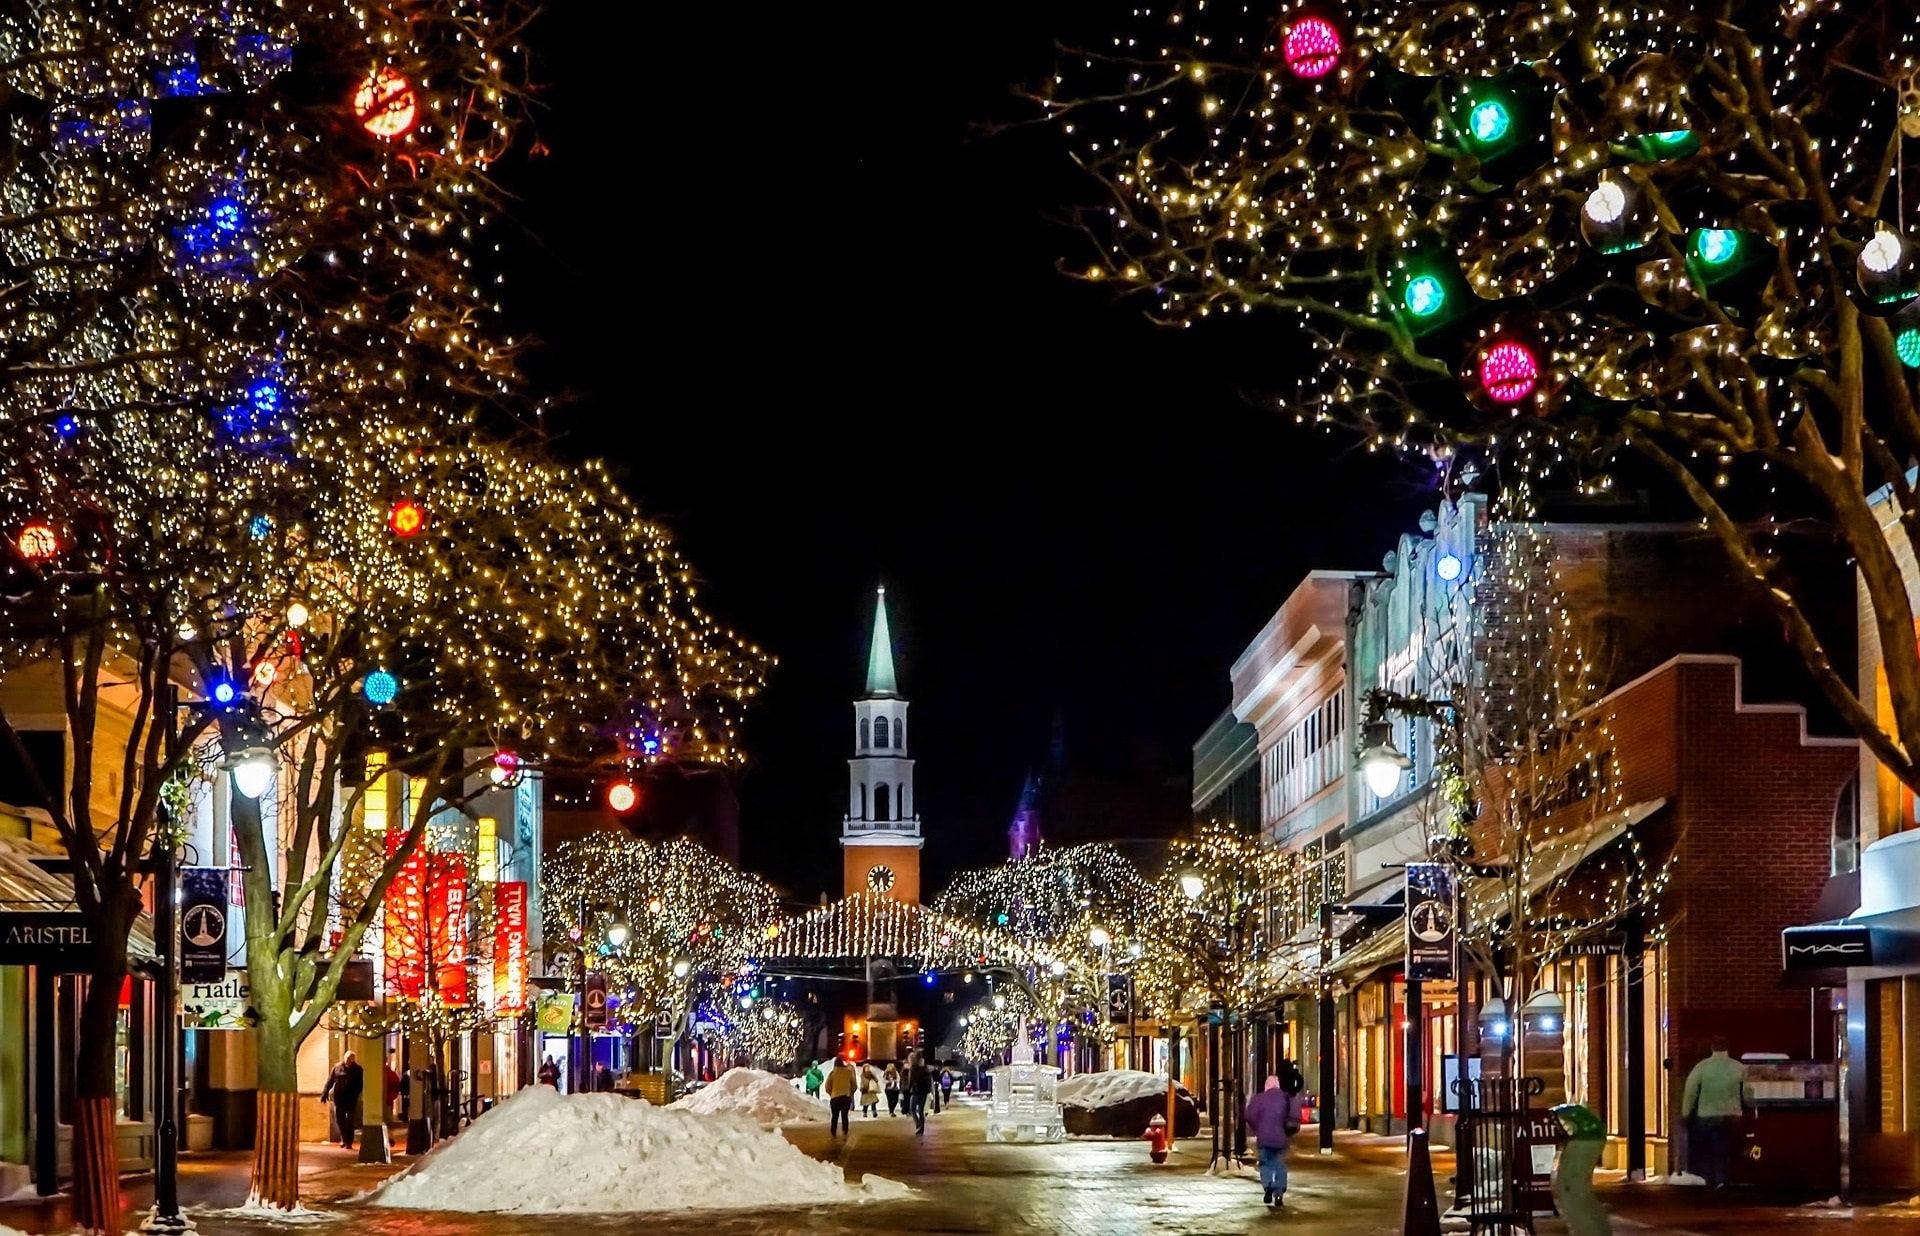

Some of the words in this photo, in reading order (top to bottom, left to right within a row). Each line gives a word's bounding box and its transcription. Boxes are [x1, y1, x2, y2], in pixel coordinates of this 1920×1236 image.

[507, 885, 522, 927] MALL
[5, 925, 93, 945] ARISTEL
[1569, 944, 1608, 955] LEAHY
